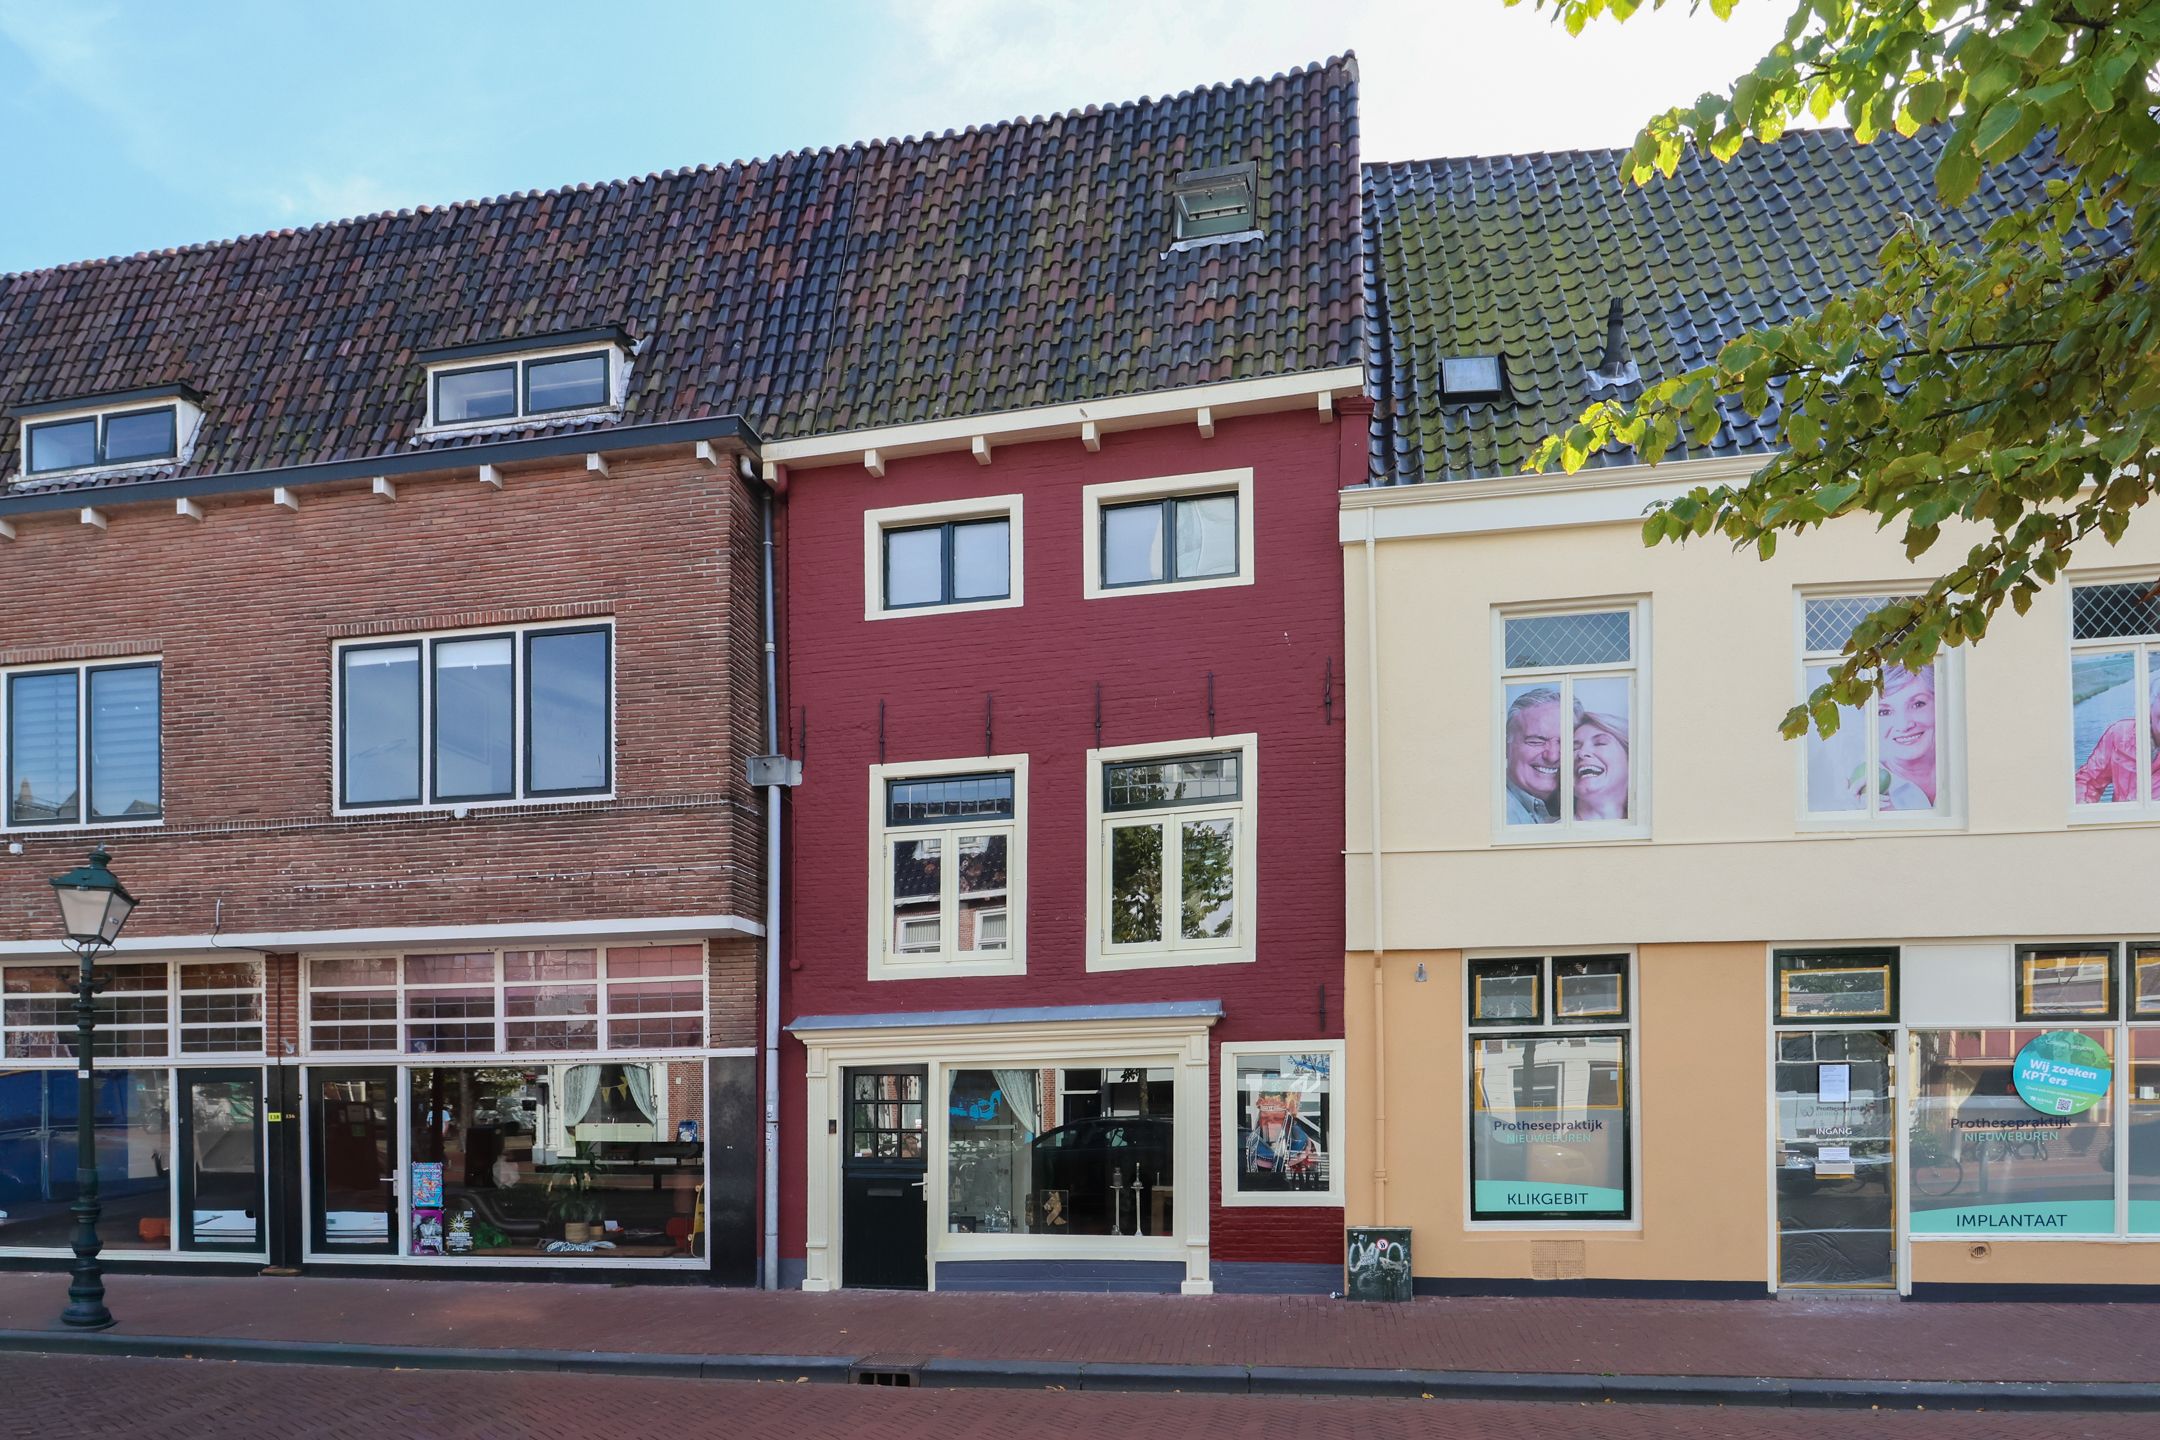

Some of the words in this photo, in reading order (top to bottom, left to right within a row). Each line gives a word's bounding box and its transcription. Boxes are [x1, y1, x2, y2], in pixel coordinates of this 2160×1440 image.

[2030, 1059, 2050, 1072] Wij
[2052, 1066, 2097, 1079] zoeken
[2022, 1069, 2068, 1086] KPT'ers
[1494, 1120, 1603, 1132] Prothesepraktijk
[1951, 1117, 2072, 1130] Prothesepraktijk
[1816, 1127, 1853, 1135] INGANG
[1964, 1131, 2059, 1142] NIEUWEBUREN
[1507, 1133, 1591, 1144] NIEUWEBUREN
[1507, 1192, 1589, 1205] KLIKGEBIT
[1956, 1214, 2068, 1227] IMPLANTAAT
